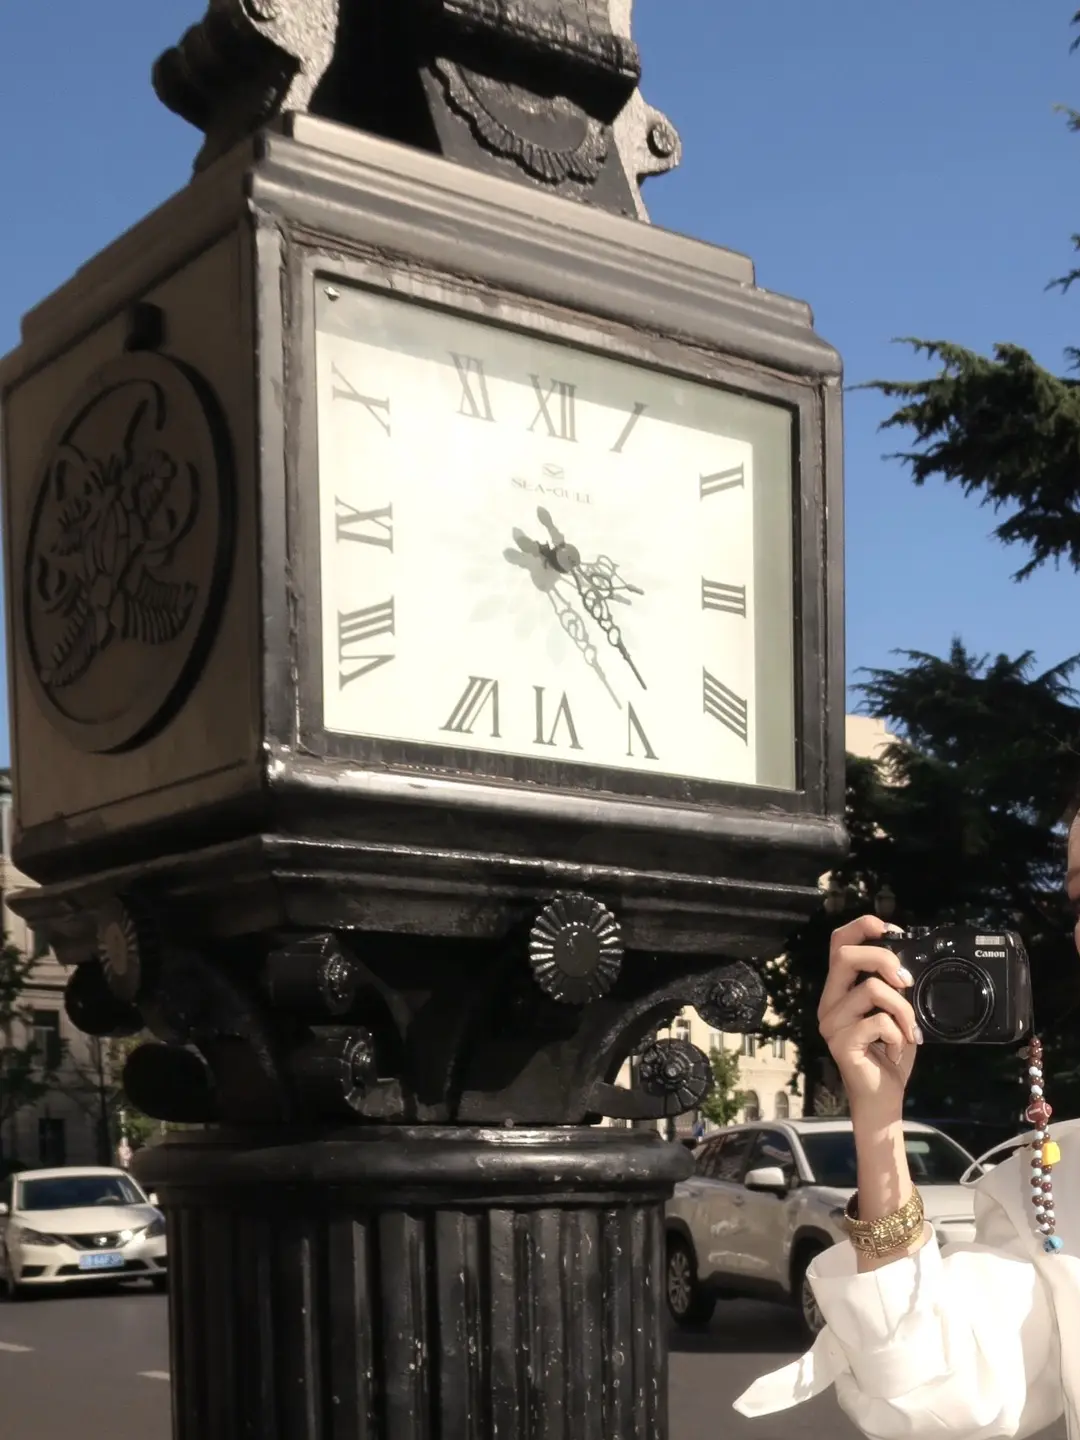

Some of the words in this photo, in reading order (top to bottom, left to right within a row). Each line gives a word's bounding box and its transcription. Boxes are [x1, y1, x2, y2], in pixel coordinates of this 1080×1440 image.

[448, 351, 496, 423] XI
[526, 373, 578, 443] XII
[335, 495, 394, 554] IX
[701, 575, 746, 618] III
[337, 595, 396, 691] VIII
[438, 675, 502, 738] VII
[532, 685, 583, 750] VI
[626, 700, 659, 760] V
[974, 949, 1006, 958] Canon
